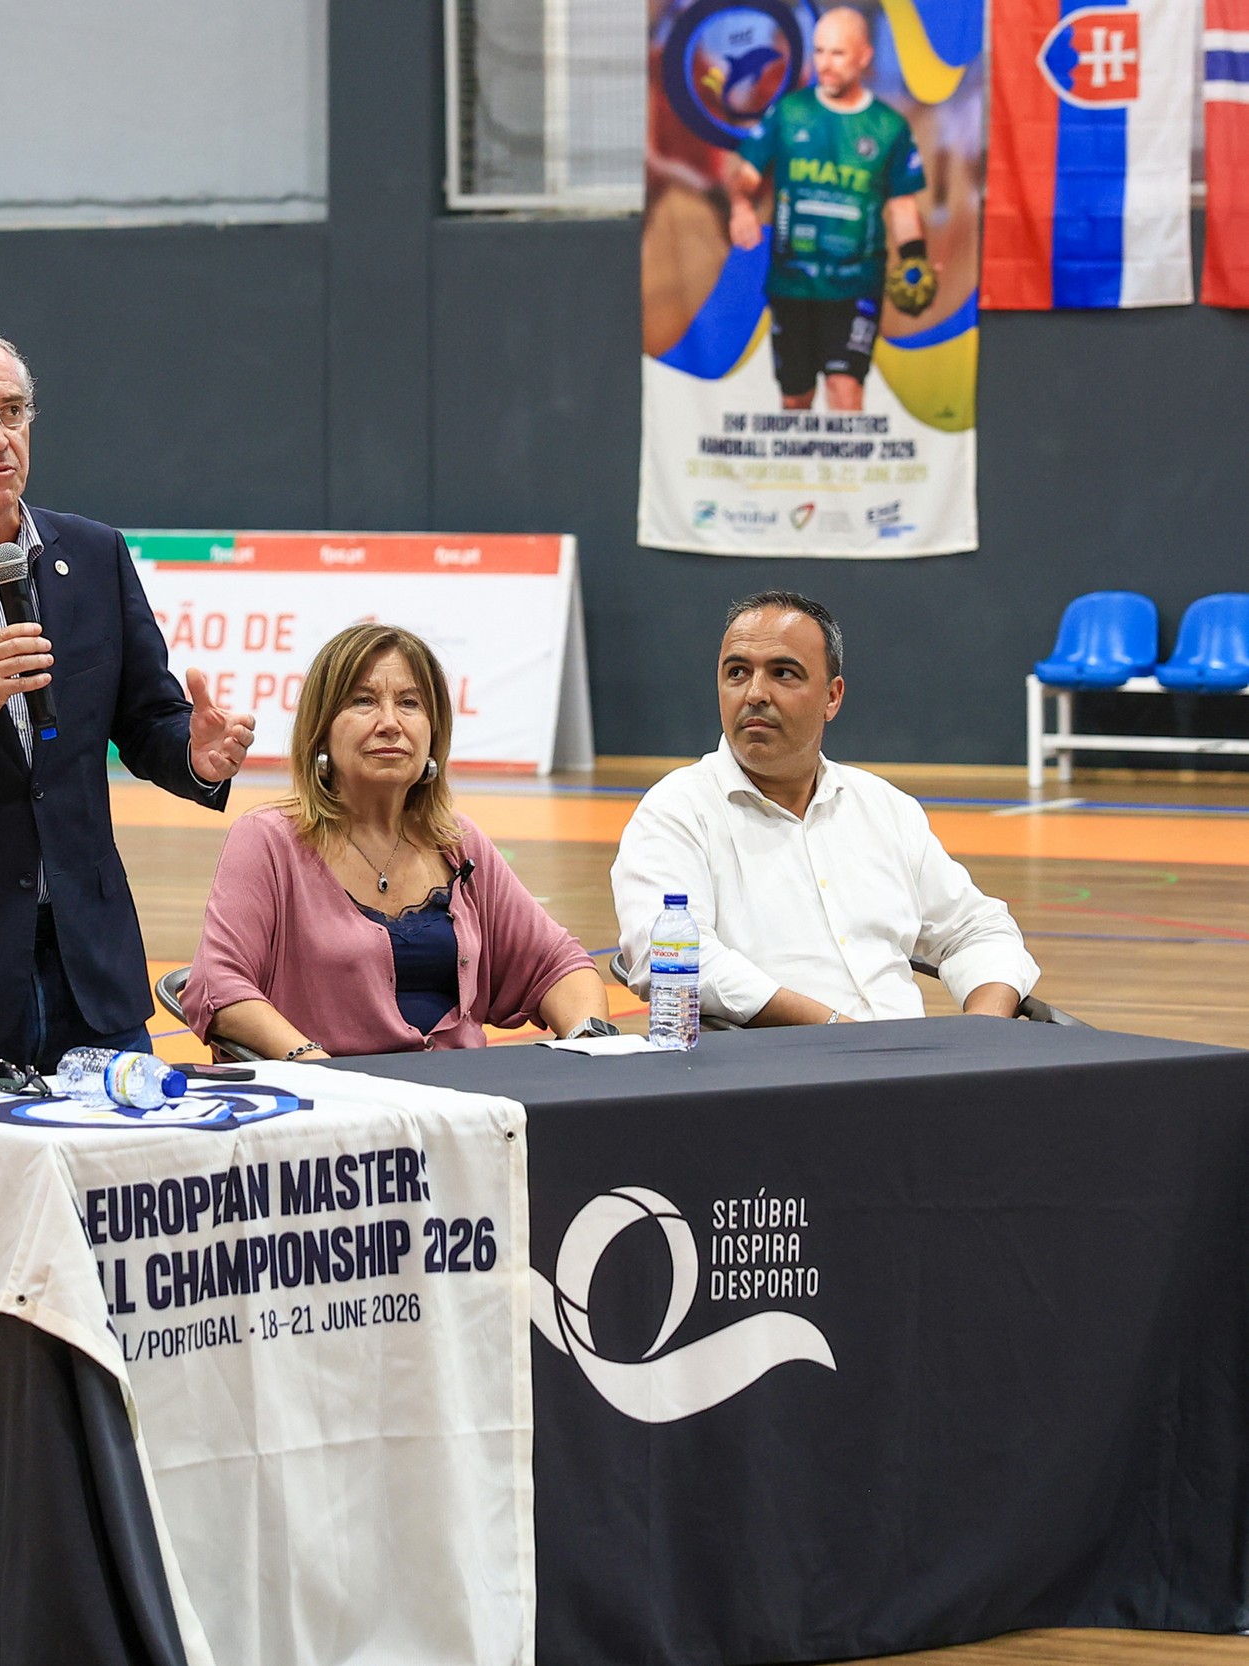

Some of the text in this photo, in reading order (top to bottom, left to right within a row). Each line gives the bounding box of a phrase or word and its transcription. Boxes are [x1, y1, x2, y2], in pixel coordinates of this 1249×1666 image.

[244, 613, 296, 652] DE
[86, 1162, 270, 1245] EUROPEAN
[712, 1186, 809, 1230] SETÚBAL
[146, 1219, 411, 1311] CHAMPIONSHIP
[711, 1233, 801, 1265] INSPIRA
[710, 1267, 819, 1301] DESPORTO
[321, 1298, 367, 1332] JUNE
[372, 1293, 421, 1325] 2026
